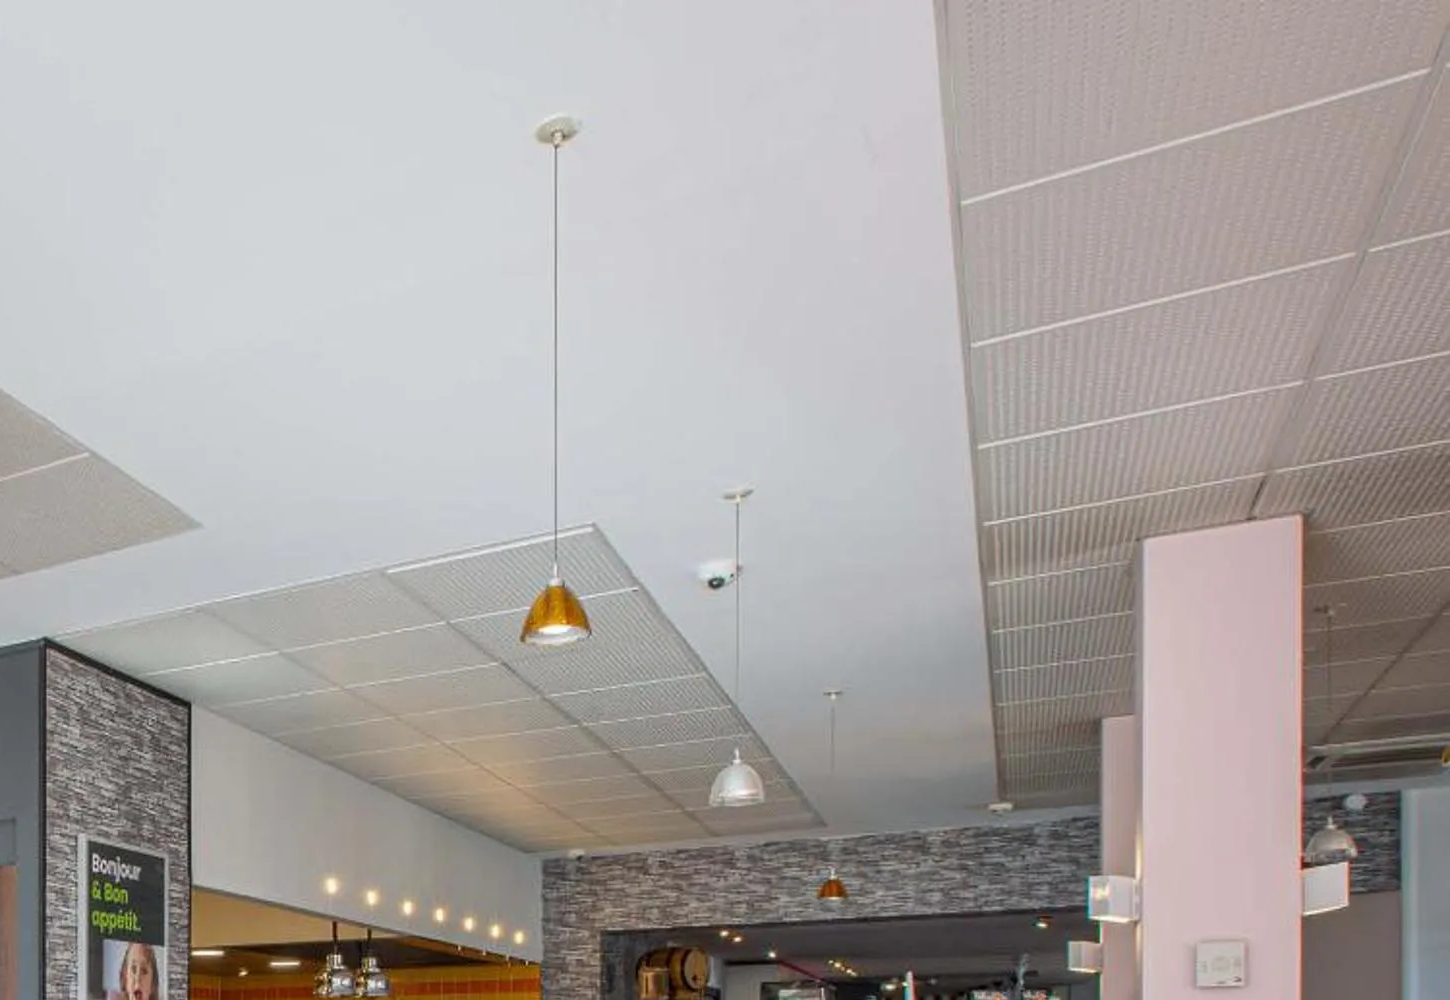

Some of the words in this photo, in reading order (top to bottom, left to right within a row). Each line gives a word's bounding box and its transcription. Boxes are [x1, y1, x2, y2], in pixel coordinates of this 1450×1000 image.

[92, 853, 142, 882] Bonjour
[92, 881, 102, 899] &
[104, 883, 128, 904] Bon
[92, 909, 142, 935] appétit.
